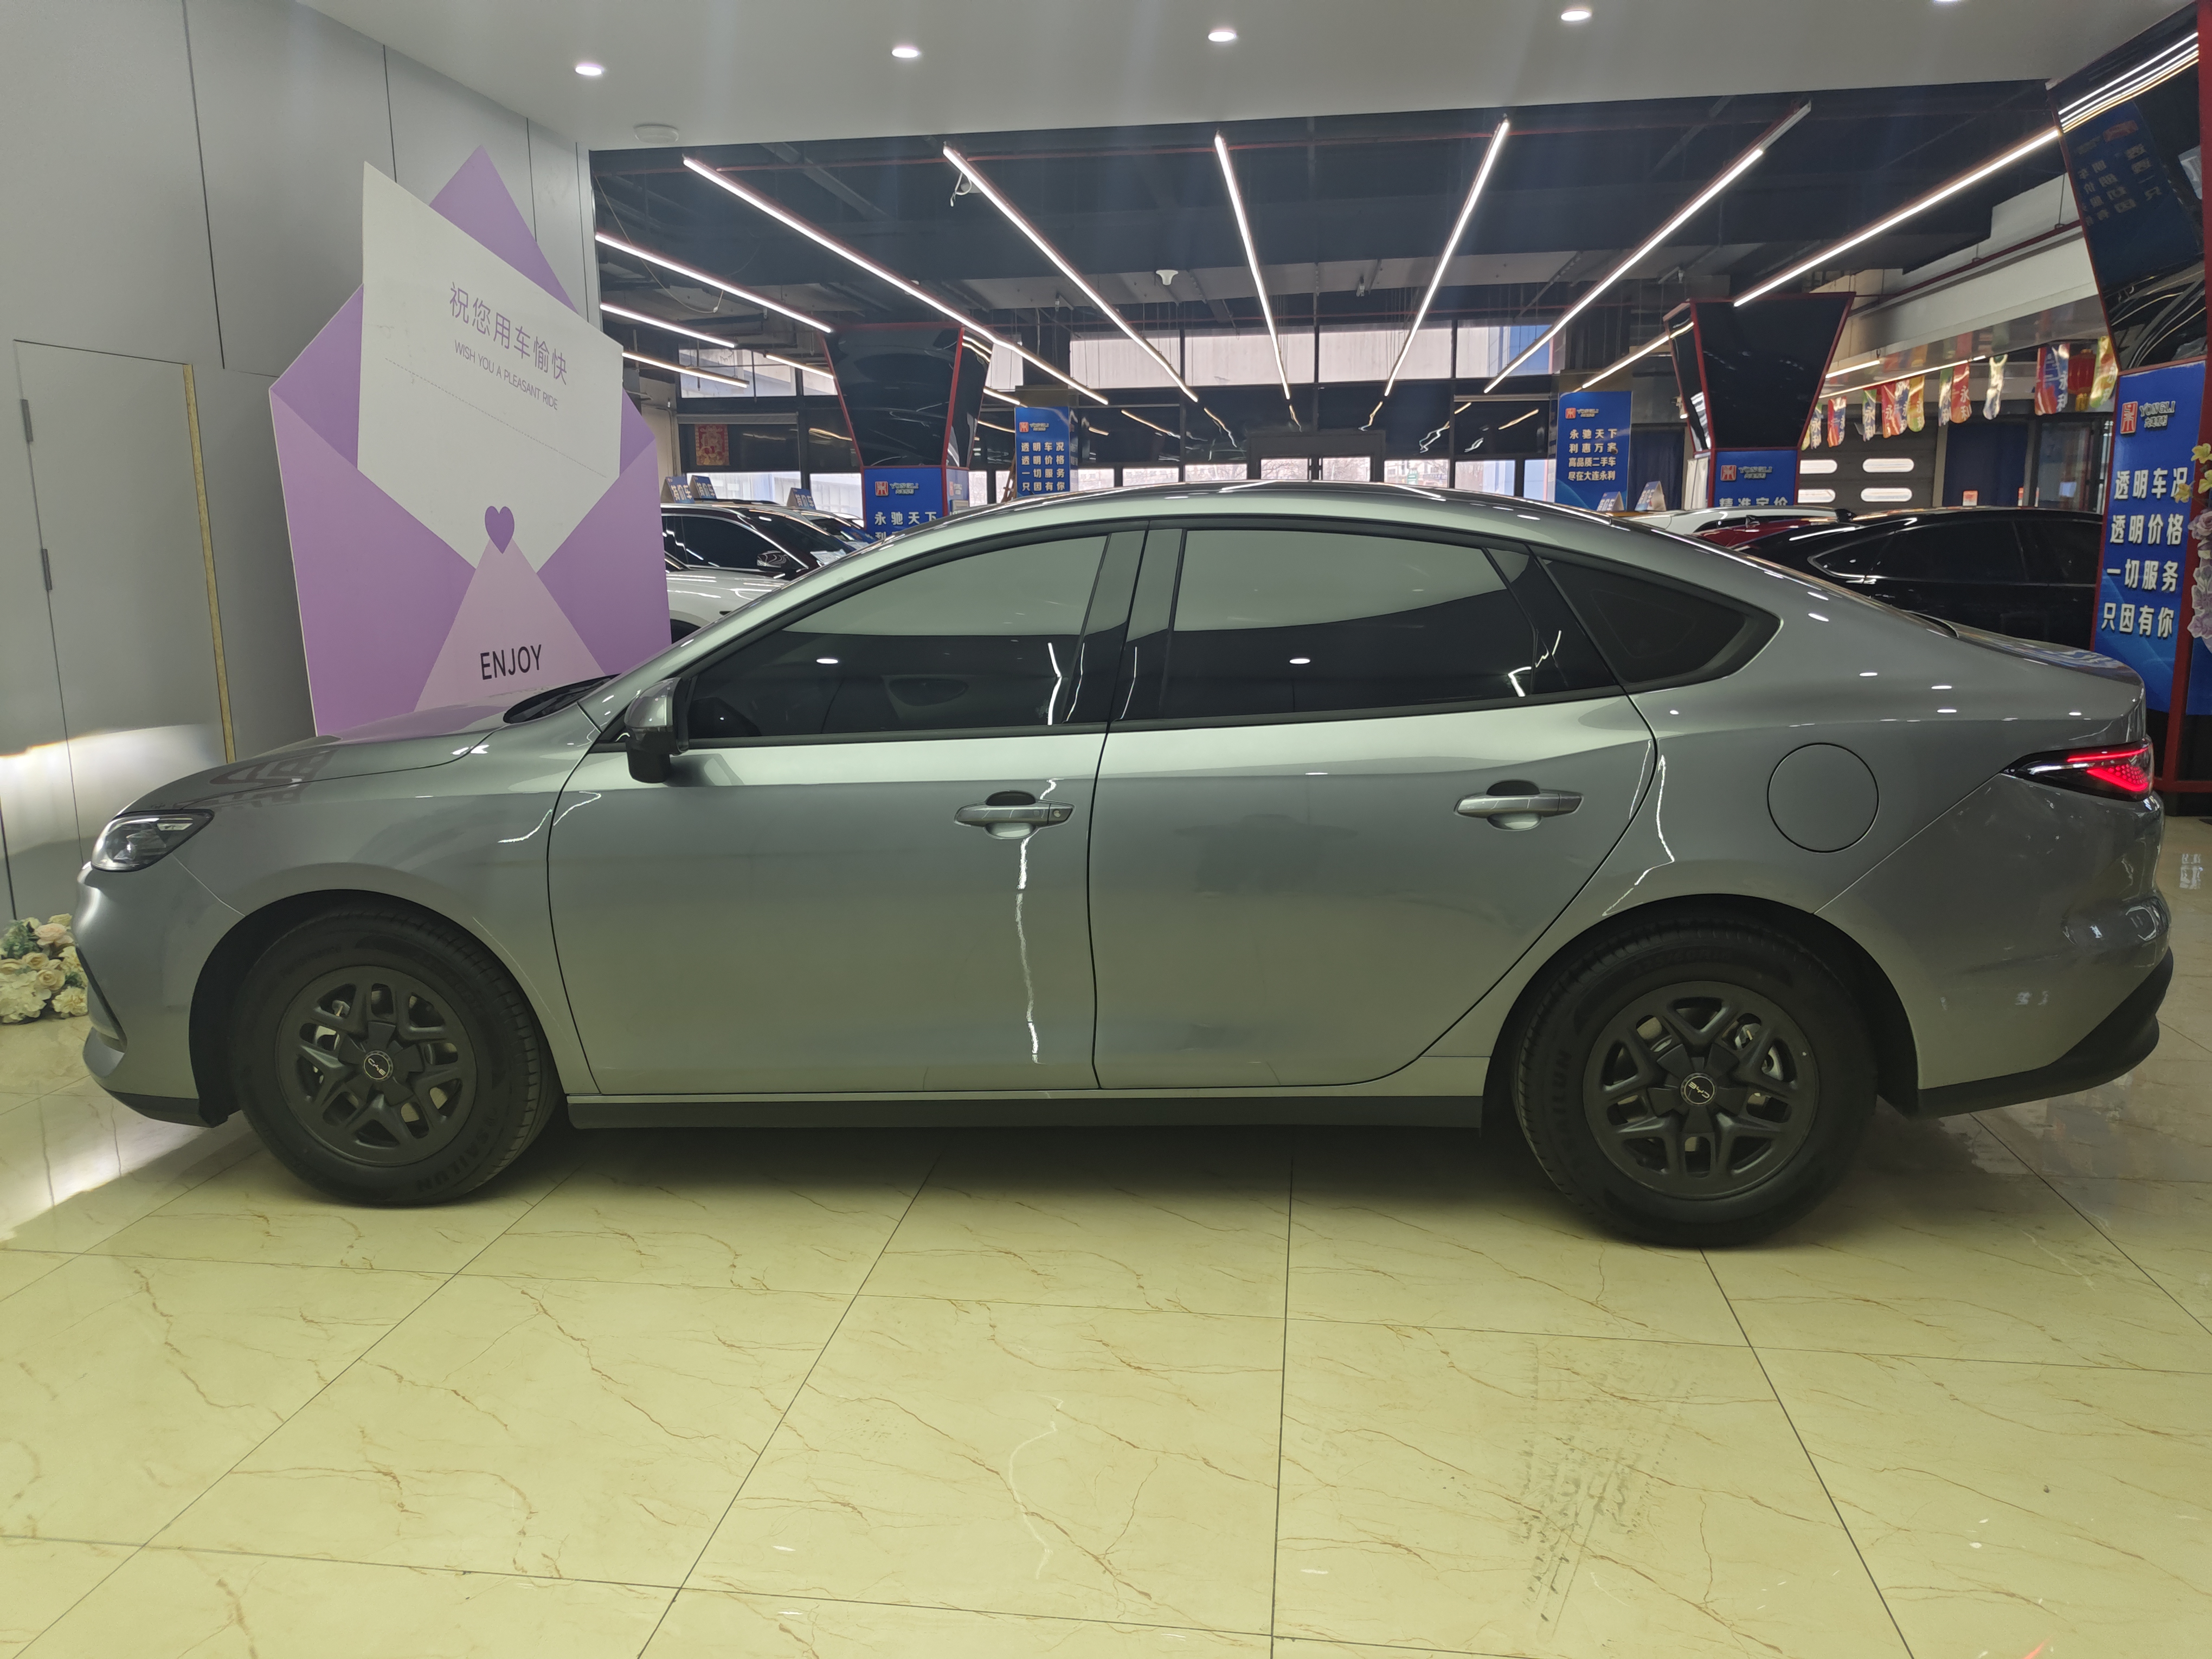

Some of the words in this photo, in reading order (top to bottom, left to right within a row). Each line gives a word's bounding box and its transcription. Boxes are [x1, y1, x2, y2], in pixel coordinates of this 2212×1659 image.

[449, 282, 567, 385] 祝您用车愉快
[455, 339, 475, 364] WISH
[478, 353, 494, 374] YOU
[496, 365, 501, 379] A
[504, 369, 541, 400] PLEASANT
[543, 391, 558, 410] RIDE
[1960, 385, 1972, 420] 永利
[2139, 401, 2176, 417] YONGLI
[1570, 428, 1617, 439] 永驰天下
[1021, 442, 1065, 452] 透明车况
[1569, 442, 1617, 453] 利惠万家
[1021, 455, 1065, 465] 透明价格
[1568, 457, 1616, 467] 高品质二手车
[1021, 468, 1065, 478] 一切服务
[1568, 471, 1616, 481] 尽在大连永利
[1022, 482, 1065, 491] 只因有你
[2114, 467, 2188, 499] 透明车况
[874, 512, 937, 525] 永驰天下
[2110, 513, 2184, 545] 透明价格
[2107, 558, 2178, 592] 一切服务
[2101, 602, 2174, 638] 只因有你
[480, 644, 542, 680] ENJOY
[368, 1058, 386, 1076] BYD
[1688, 1082, 1710, 1098] BYD
